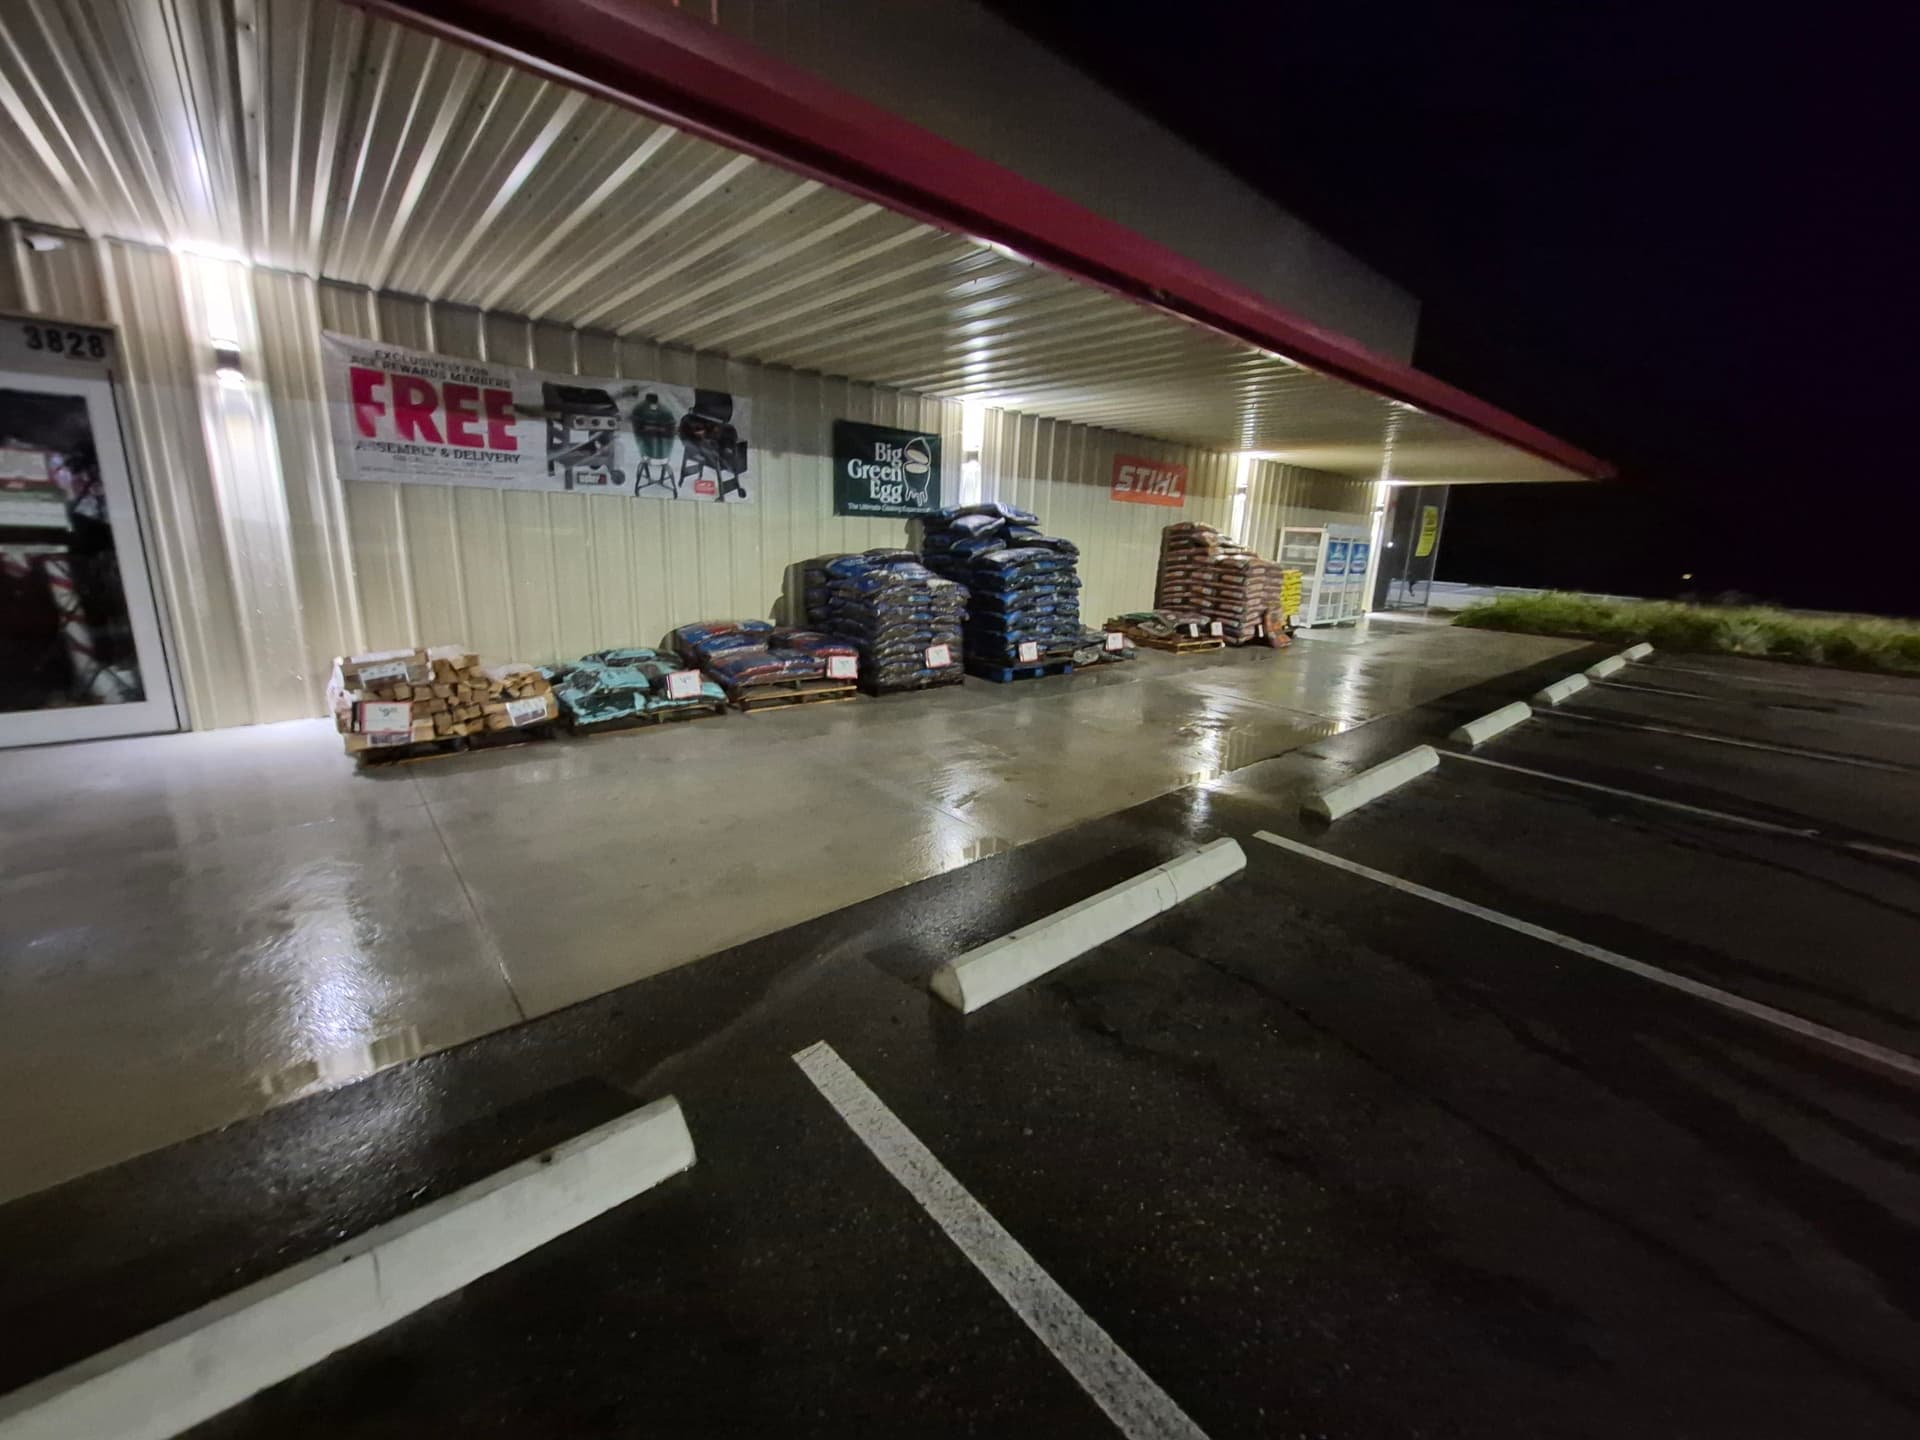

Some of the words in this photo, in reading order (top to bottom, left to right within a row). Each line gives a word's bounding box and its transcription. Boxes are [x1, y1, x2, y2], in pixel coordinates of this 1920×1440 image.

[22, 325, 106, 358] 3828
[375, 350, 461, 371] EXCLUSIVELY
[464, 366, 489, 376] FOR
[382, 361, 448, 380] REWARDS
[450, 373, 511, 388] MEMBERS
[350, 368, 518, 451] FREE
[440, 448, 450, 457] &
[453, 450, 521, 465] DELIVERY
[875, 442, 902, 467] Big
[847, 458, 902, 481] Green
[1115, 465, 1181, 498] STIHL
[870, 480, 902, 504] Egg
